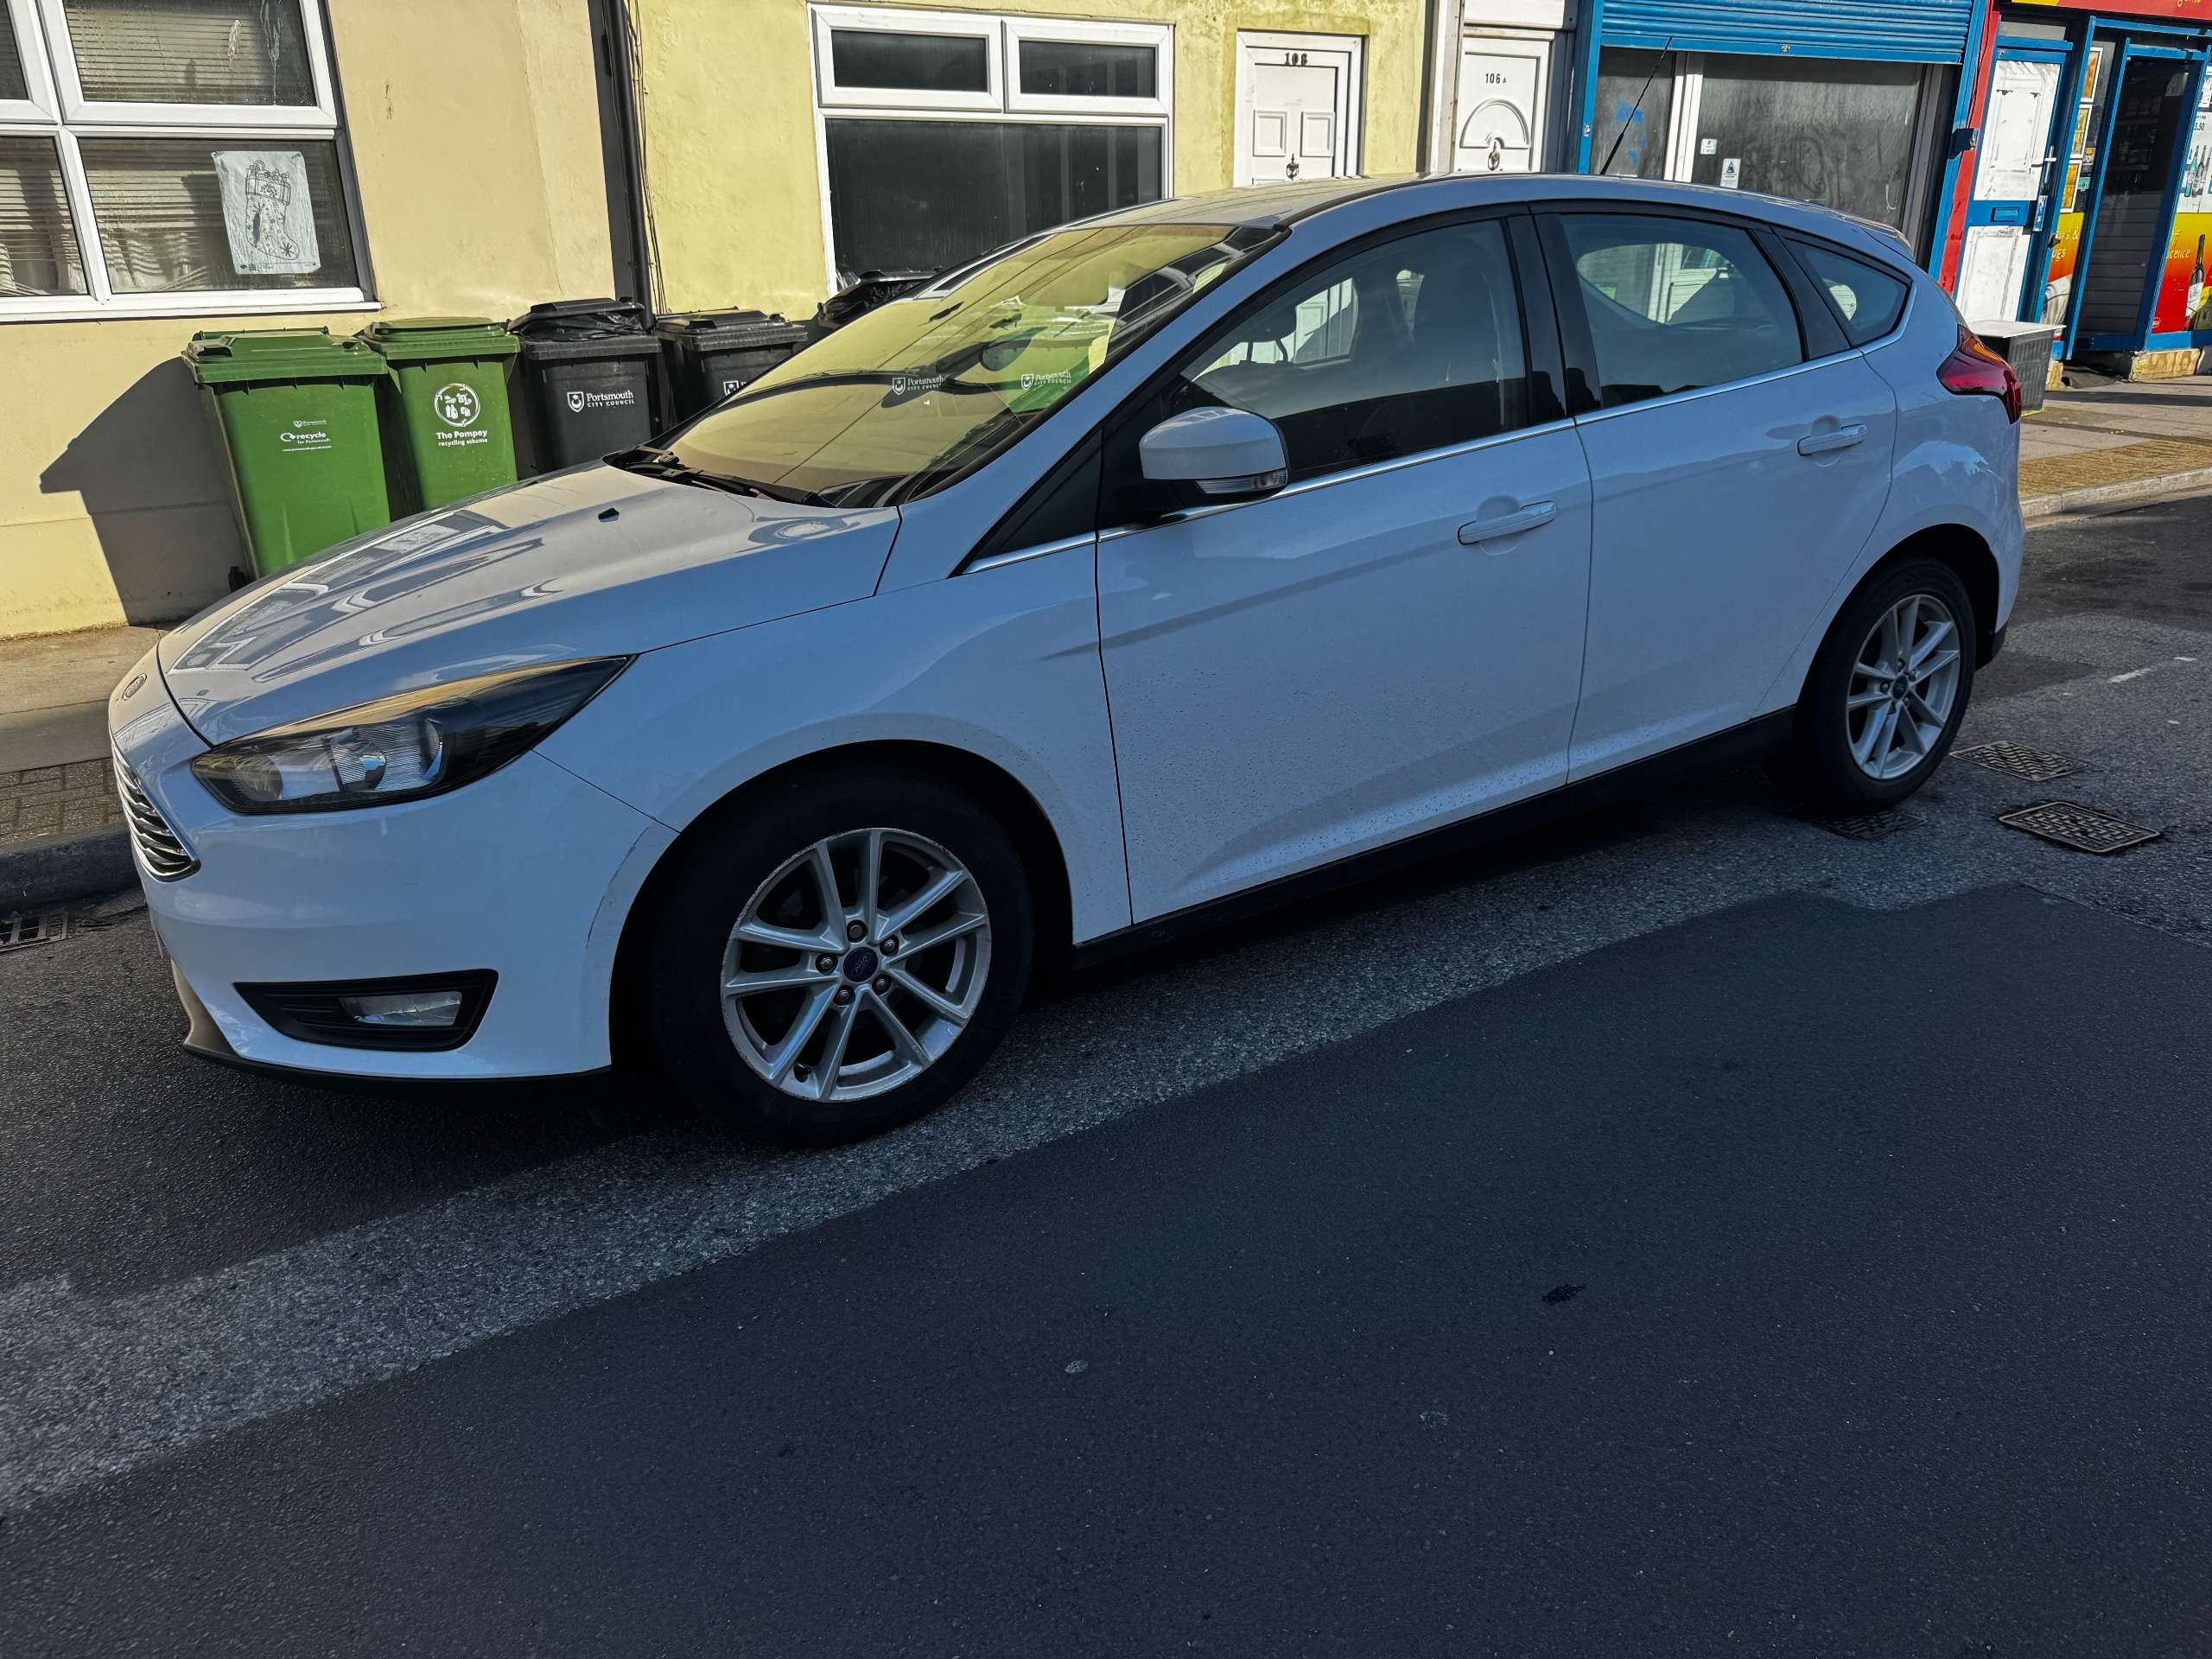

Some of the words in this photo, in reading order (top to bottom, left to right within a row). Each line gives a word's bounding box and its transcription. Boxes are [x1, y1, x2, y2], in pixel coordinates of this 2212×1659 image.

[1284, 53, 1307, 67] 108
[907, 374, 944, 385] Portsmouth
[586, 390, 634, 402] Portsmouth
[296, 431, 327, 440] recycle
[435, 431, 453, 440] The
[454, 429, 487, 438] Pompey
